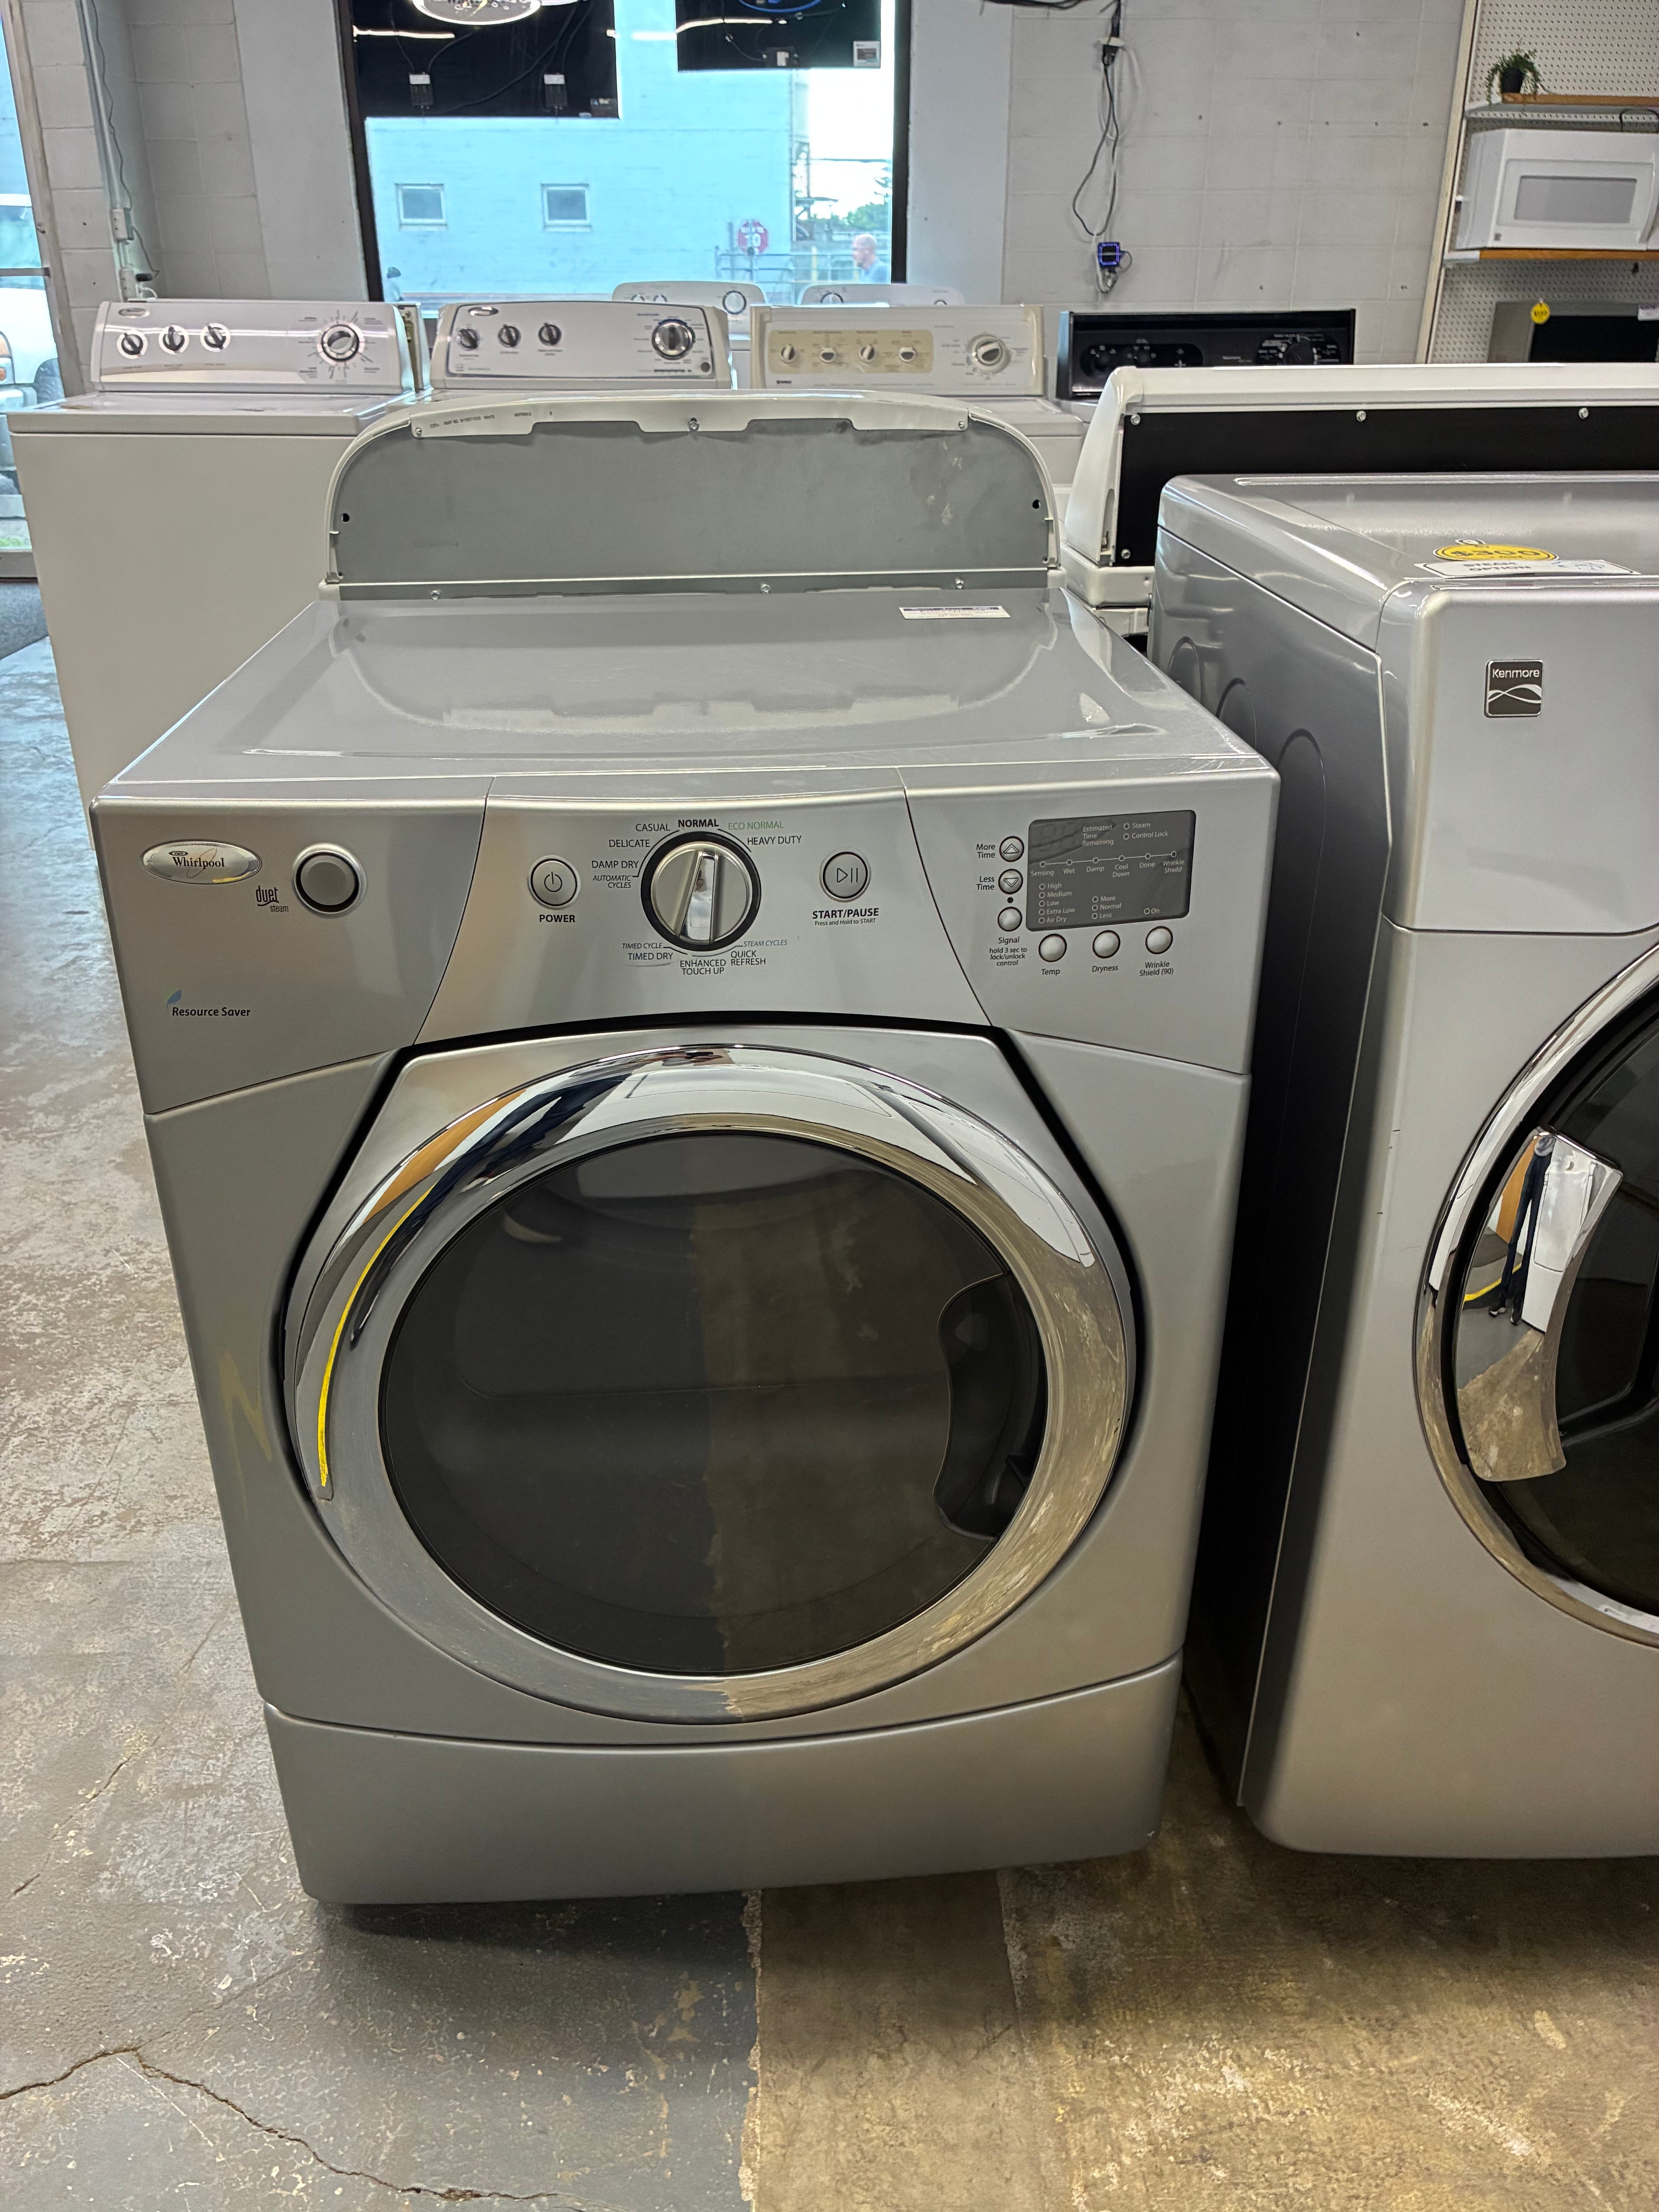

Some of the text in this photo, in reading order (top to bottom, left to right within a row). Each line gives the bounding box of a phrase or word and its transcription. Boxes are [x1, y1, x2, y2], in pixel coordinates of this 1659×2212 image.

[1492, 669, 1540, 678] Kenmore
[635, 823, 670, 831] CASUAL
[678, 819, 719, 828] NORMAL
[747, 821, 783, 830] NORMAL
[747, 835, 802, 845] HEAVY DUTY
[1082, 838, 1114, 847] Remaining
[172, 857, 225, 869] Whirlpool
[592, 860, 639, 869] DAMP DRY
[256, 885, 279, 906] duet
[812, 908, 879, 919] START/PAUSE
[998, 936, 1020, 945] Signal
[680, 959, 726, 967] ENHANCED
[1092, 965, 1118, 974] Dryness
[172, 1007, 251, 1016] Resource Saver
